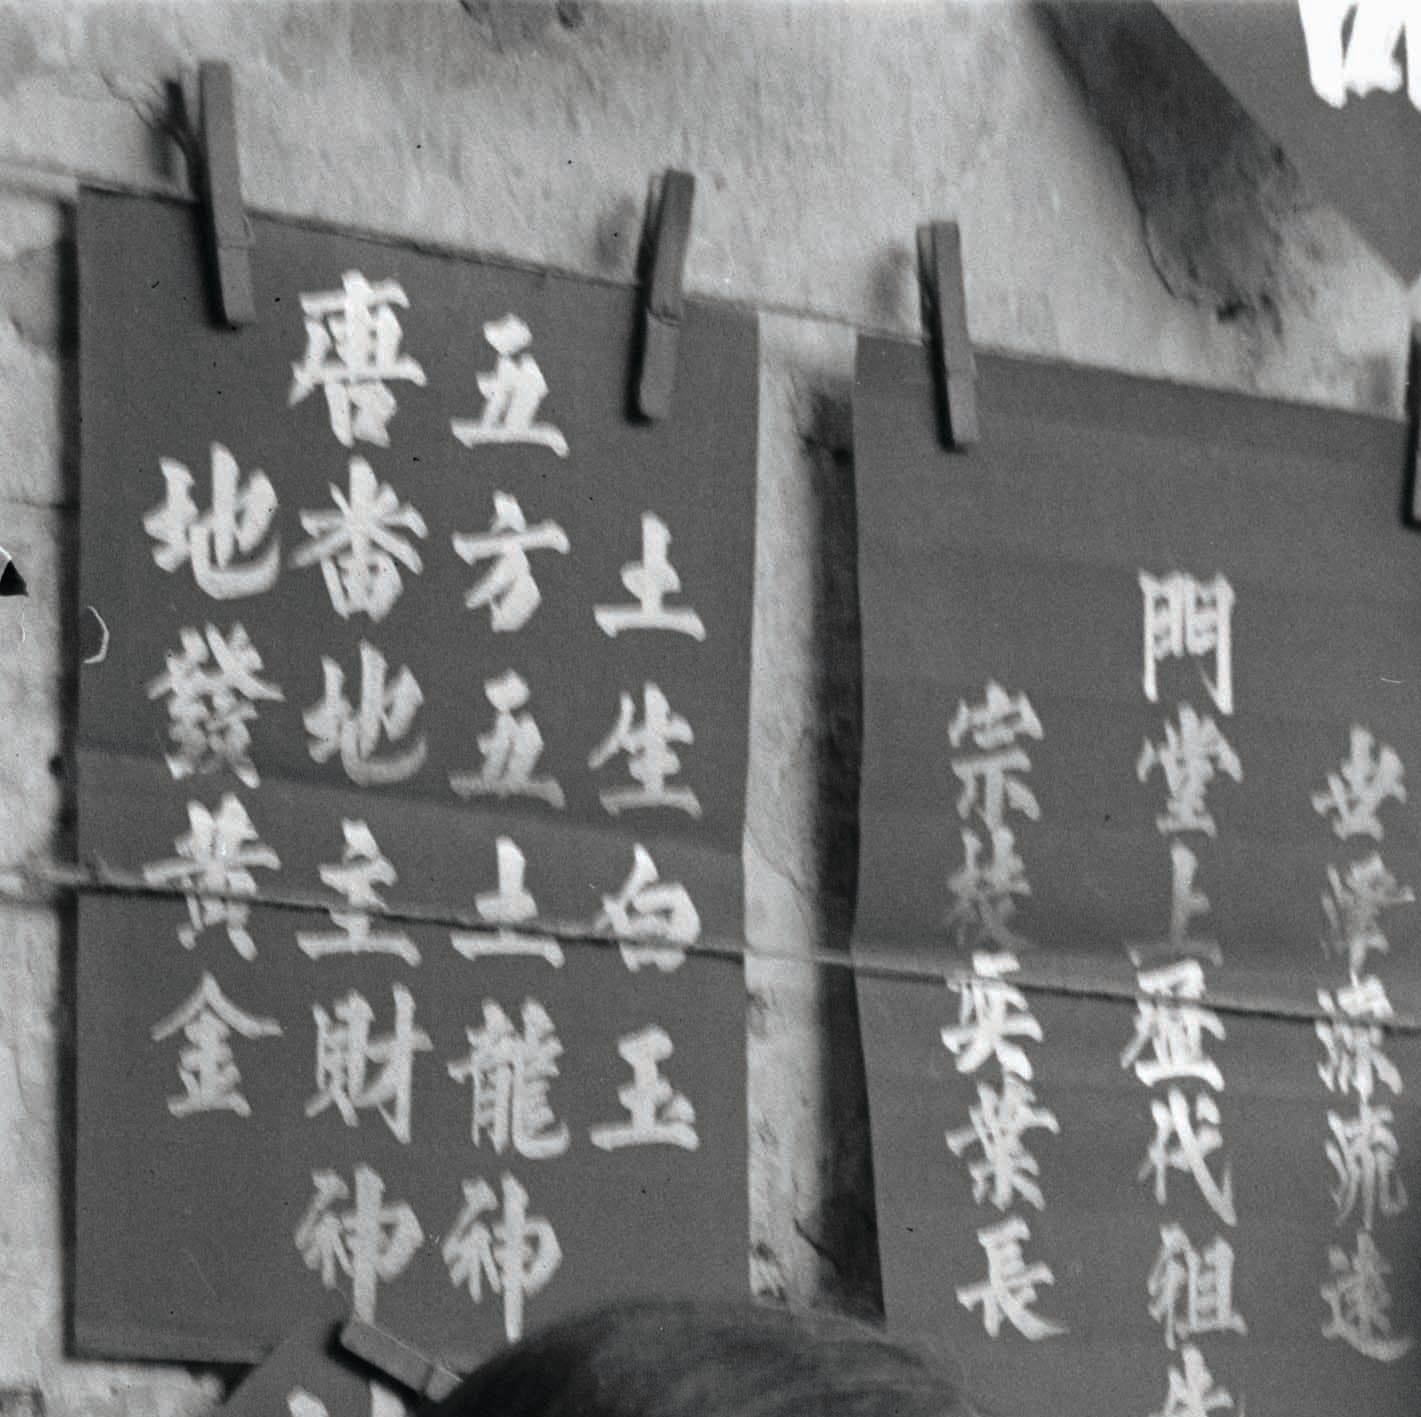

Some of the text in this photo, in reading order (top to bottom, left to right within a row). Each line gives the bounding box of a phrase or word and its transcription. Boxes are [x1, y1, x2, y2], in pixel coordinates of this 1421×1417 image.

[442, 313, 571, 1342] 五方五土龍神
[588, 511, 706, 1150] 土生白玉
